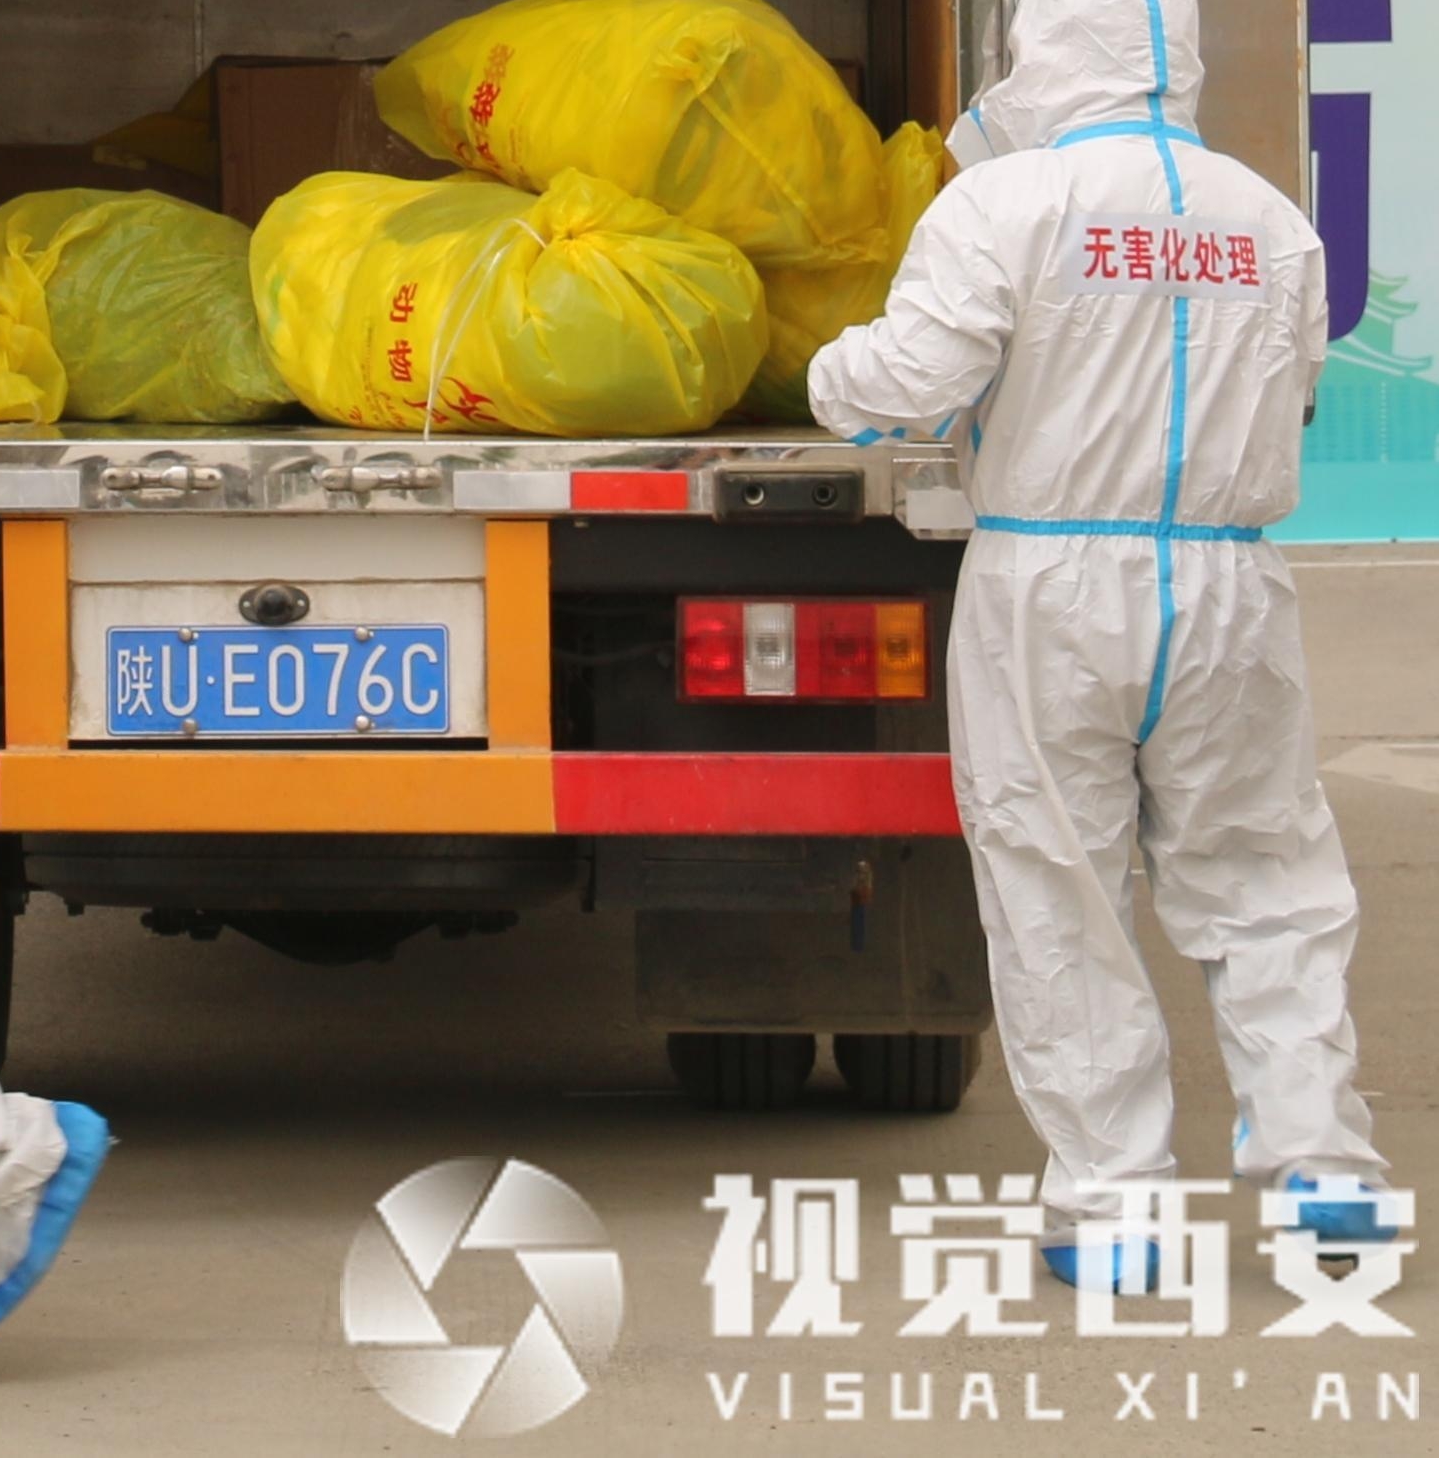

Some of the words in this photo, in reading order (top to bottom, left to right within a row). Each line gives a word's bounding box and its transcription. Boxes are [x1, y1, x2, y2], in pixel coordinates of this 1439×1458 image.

[1082, 225, 1262, 287] 无害化处理
